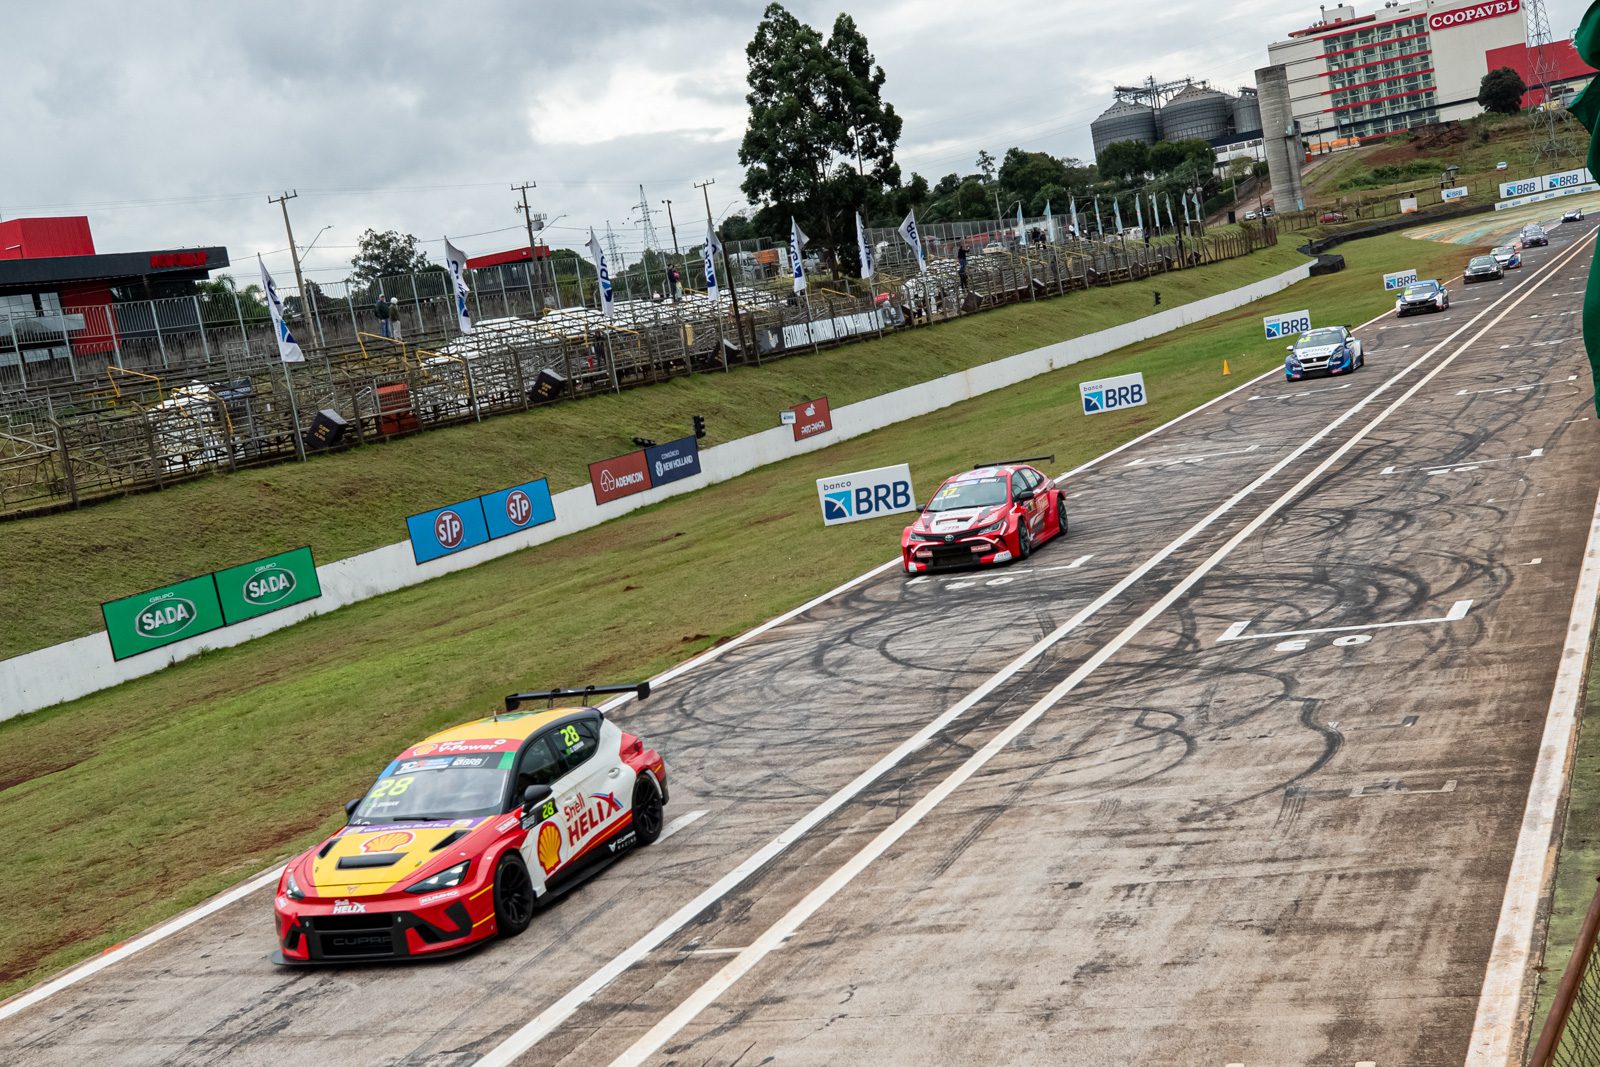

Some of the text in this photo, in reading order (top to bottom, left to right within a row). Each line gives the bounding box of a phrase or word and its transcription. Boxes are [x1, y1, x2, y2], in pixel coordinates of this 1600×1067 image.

[1431, 0, 1518, 28] COOPAVEL
[1516, 182, 1536, 195] BRB
[1559, 174, 1579, 187] BRB
[1281, 317, 1309, 335] BRB
[1083, 384, 1103, 392] banco
[1105, 384, 1143, 408] BRB
[663, 454, 693, 472] NEW HOLLAND
[615, 471, 644, 489] ADEMICON
[823, 480, 852, 491] banco
[855, 480, 911, 515] BRB
[509, 493, 529, 522] STP
[438, 514, 460, 544] STP
[255, 562, 277, 573] GRUPO
[249, 573, 290, 599] SADA
[149, 591, 174, 603] GRUPO
[141, 603, 190, 631] SADA
[560, 725, 580, 747] 28
[438, 743, 497, 752] V-Power
[368, 777, 415, 798] 28
[542, 801, 555, 819] 28
[563, 791, 586, 822] Shell
[566, 791, 624, 848] HELIX
[333, 902, 367, 914] HELIX
